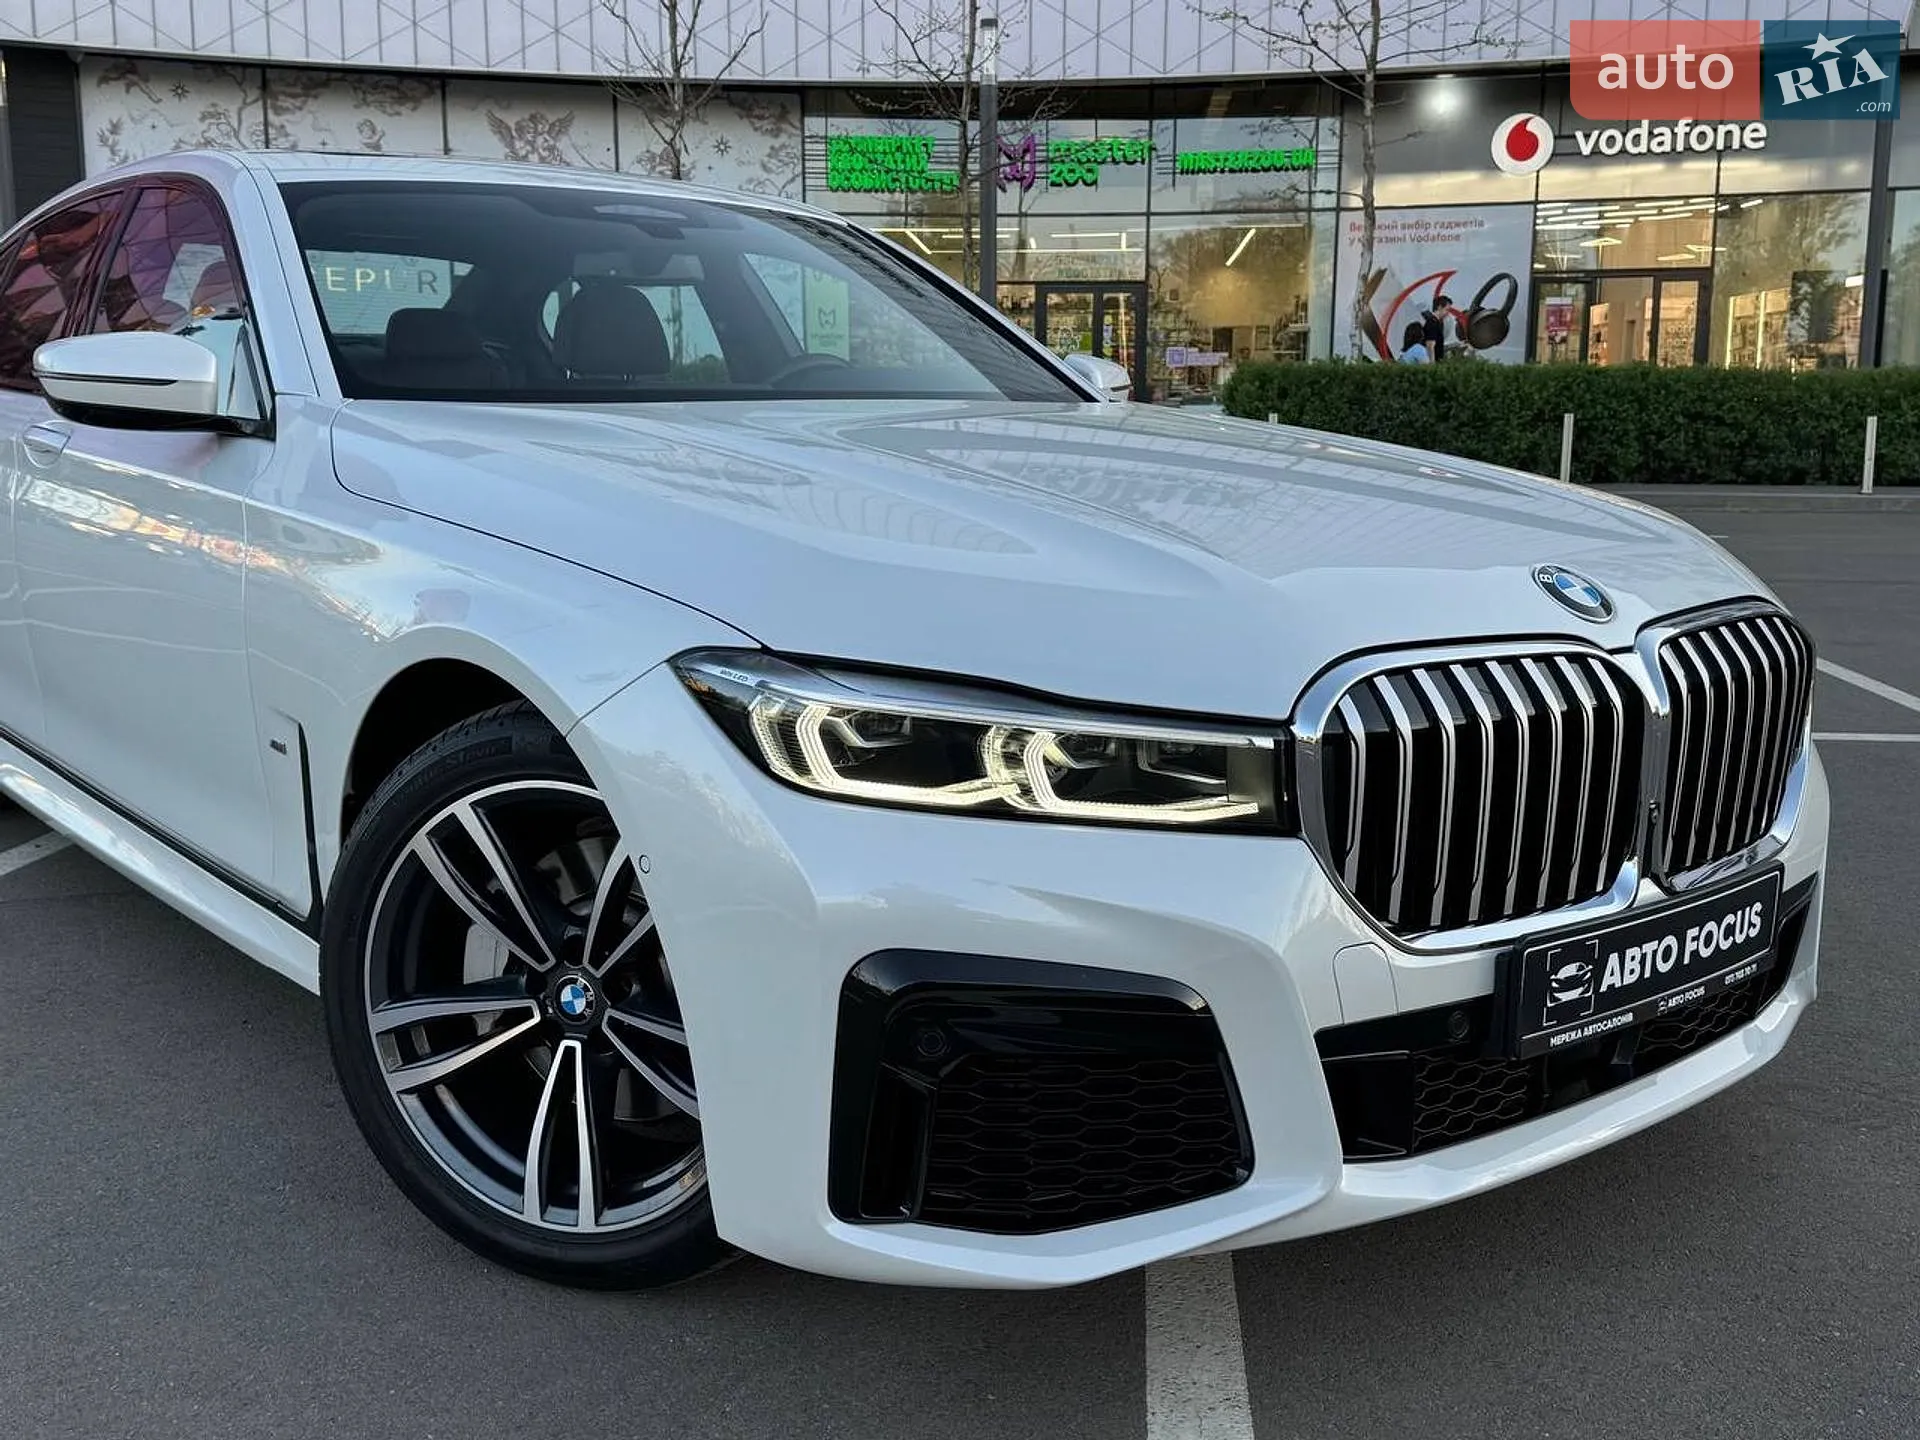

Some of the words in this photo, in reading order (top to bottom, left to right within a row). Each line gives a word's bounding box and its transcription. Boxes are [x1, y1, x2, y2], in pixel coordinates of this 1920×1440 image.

[1575, 118, 1767, 157] vodafone
[1600, 934, 1678, 992] АВТО
[1684, 902, 1762, 965] FOCUS
